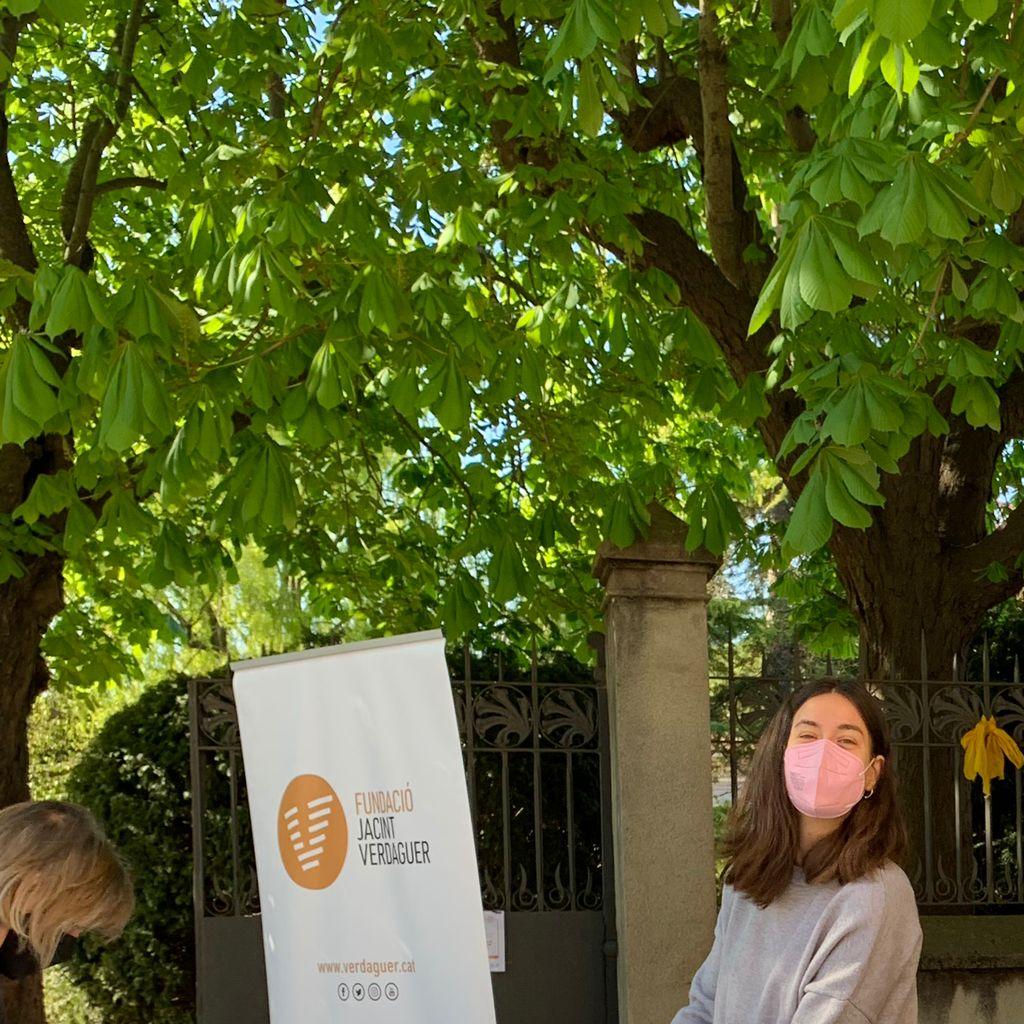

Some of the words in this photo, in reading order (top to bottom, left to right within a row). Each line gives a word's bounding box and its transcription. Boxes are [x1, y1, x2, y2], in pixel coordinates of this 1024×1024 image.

[355, 781, 414, 815] FUNDACIÓ
[357, 816, 396, 841] JACINT
[358, 841, 431, 866] VERDAGUER
[317, 959, 416, 977] www.verdaguer.cat
